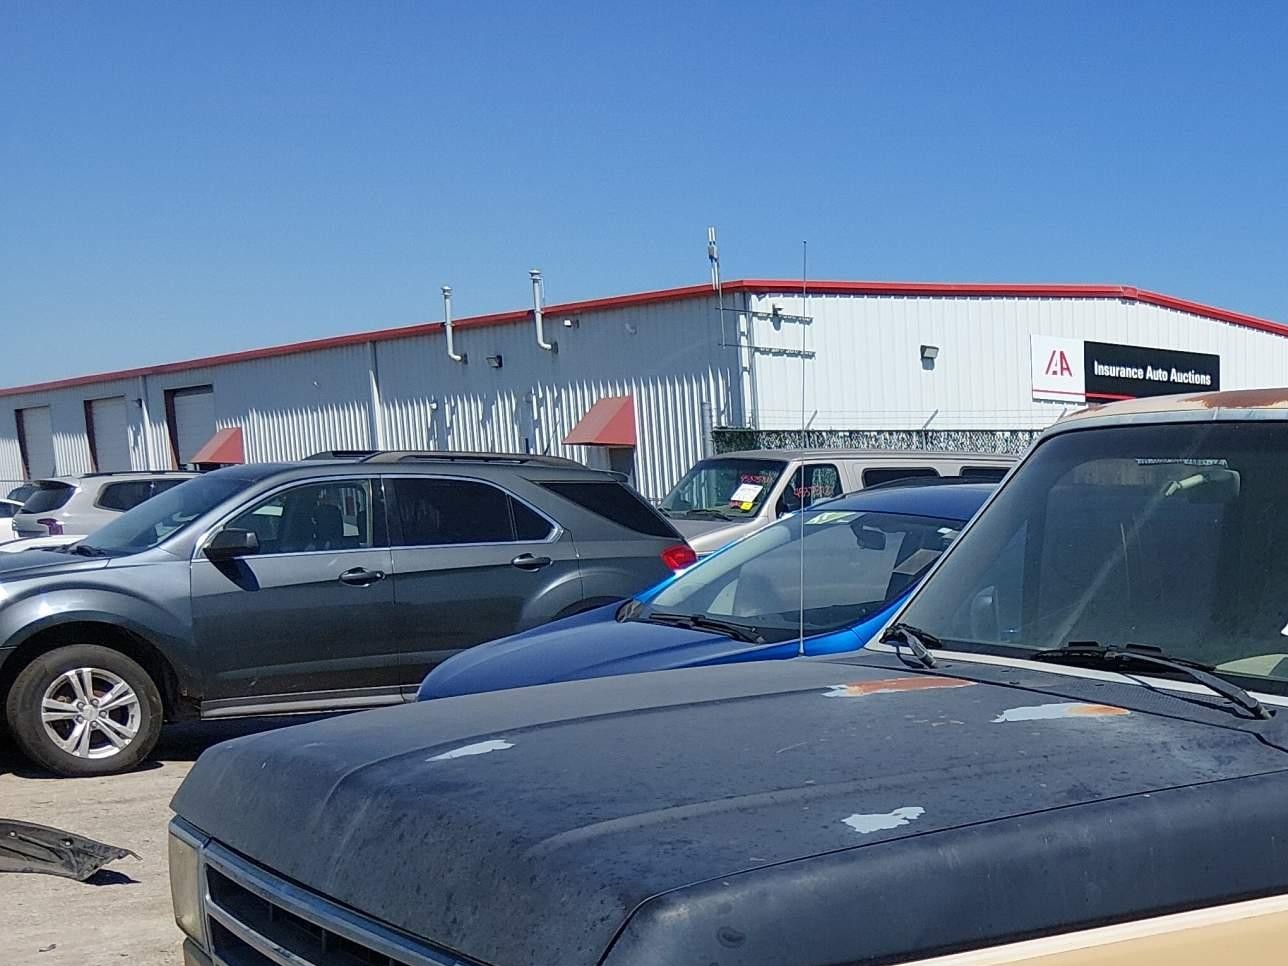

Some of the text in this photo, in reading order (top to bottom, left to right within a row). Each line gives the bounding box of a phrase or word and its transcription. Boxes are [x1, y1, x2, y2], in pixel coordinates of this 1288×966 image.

[1094, 360, 1212, 386] Insurance Auto Auctions
